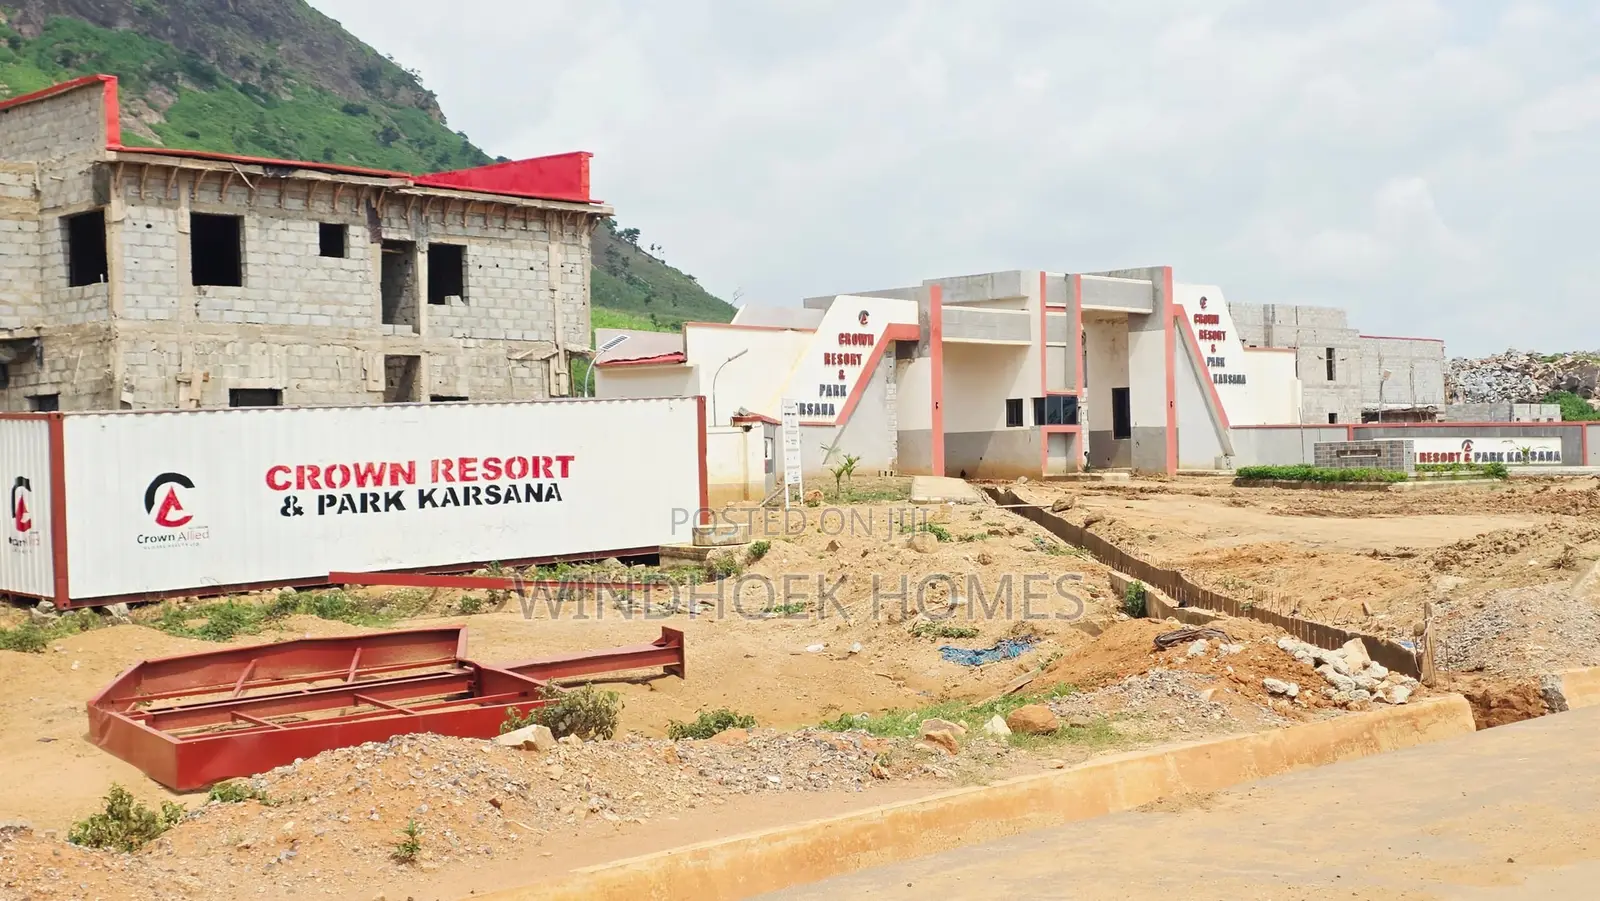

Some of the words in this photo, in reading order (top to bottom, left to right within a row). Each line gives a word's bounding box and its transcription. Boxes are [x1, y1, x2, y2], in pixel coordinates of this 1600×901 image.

[838, 333, 874, 346] CROWN
[1199, 329, 1226, 341] RESORT
[824, 352, 862, 365] RESORT
[1207, 356, 1225, 367] PARK
[838, 369, 845, 380] &
[1213, 373, 1246, 385] KARSANA
[819, 384, 847, 397] PARK
[796, 402, 835, 416] RSANA
[1419, 451, 1461, 463] RESORT
[1464, 452, 1472, 463] &
[1474, 451, 1504, 462] PARK
[265, 460, 416, 491] CROWN
[431, 455, 575, 483] RESORT
[280, 495, 304, 517] &
[317, 490, 406, 516] PARK
[418, 483, 562, 509] KARSANA
[137, 533, 175, 544] Crown
[178, 528, 209, 541] Allied
